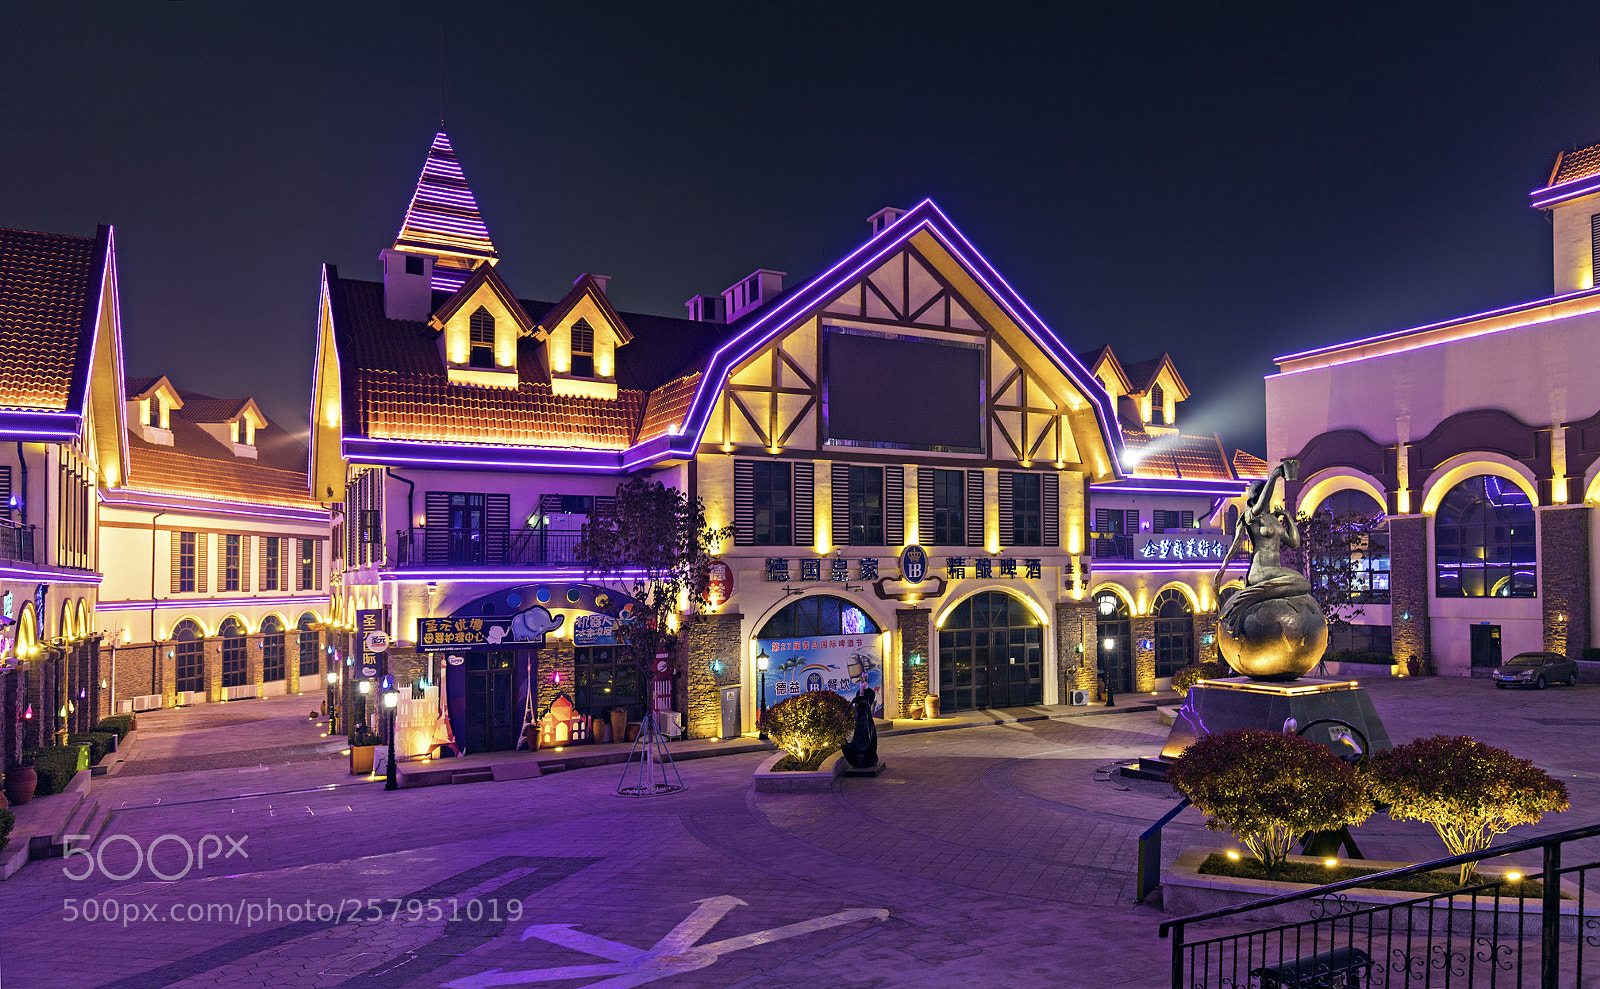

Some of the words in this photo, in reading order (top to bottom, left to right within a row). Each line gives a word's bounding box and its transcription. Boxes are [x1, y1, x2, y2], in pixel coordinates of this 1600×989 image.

[765, 557, 880, 582] 德国皇家
[946, 557, 1041, 580] 精酿啤酒
[574, 615, 613, 628] 机器人
[423, 631, 485, 644] 母婴护理中心
[771, 639, 864, 652] 第27届青岛国际啤酒节
[775, 681, 801, 696] 德益
[826, 677, 851, 692] 餐饮
